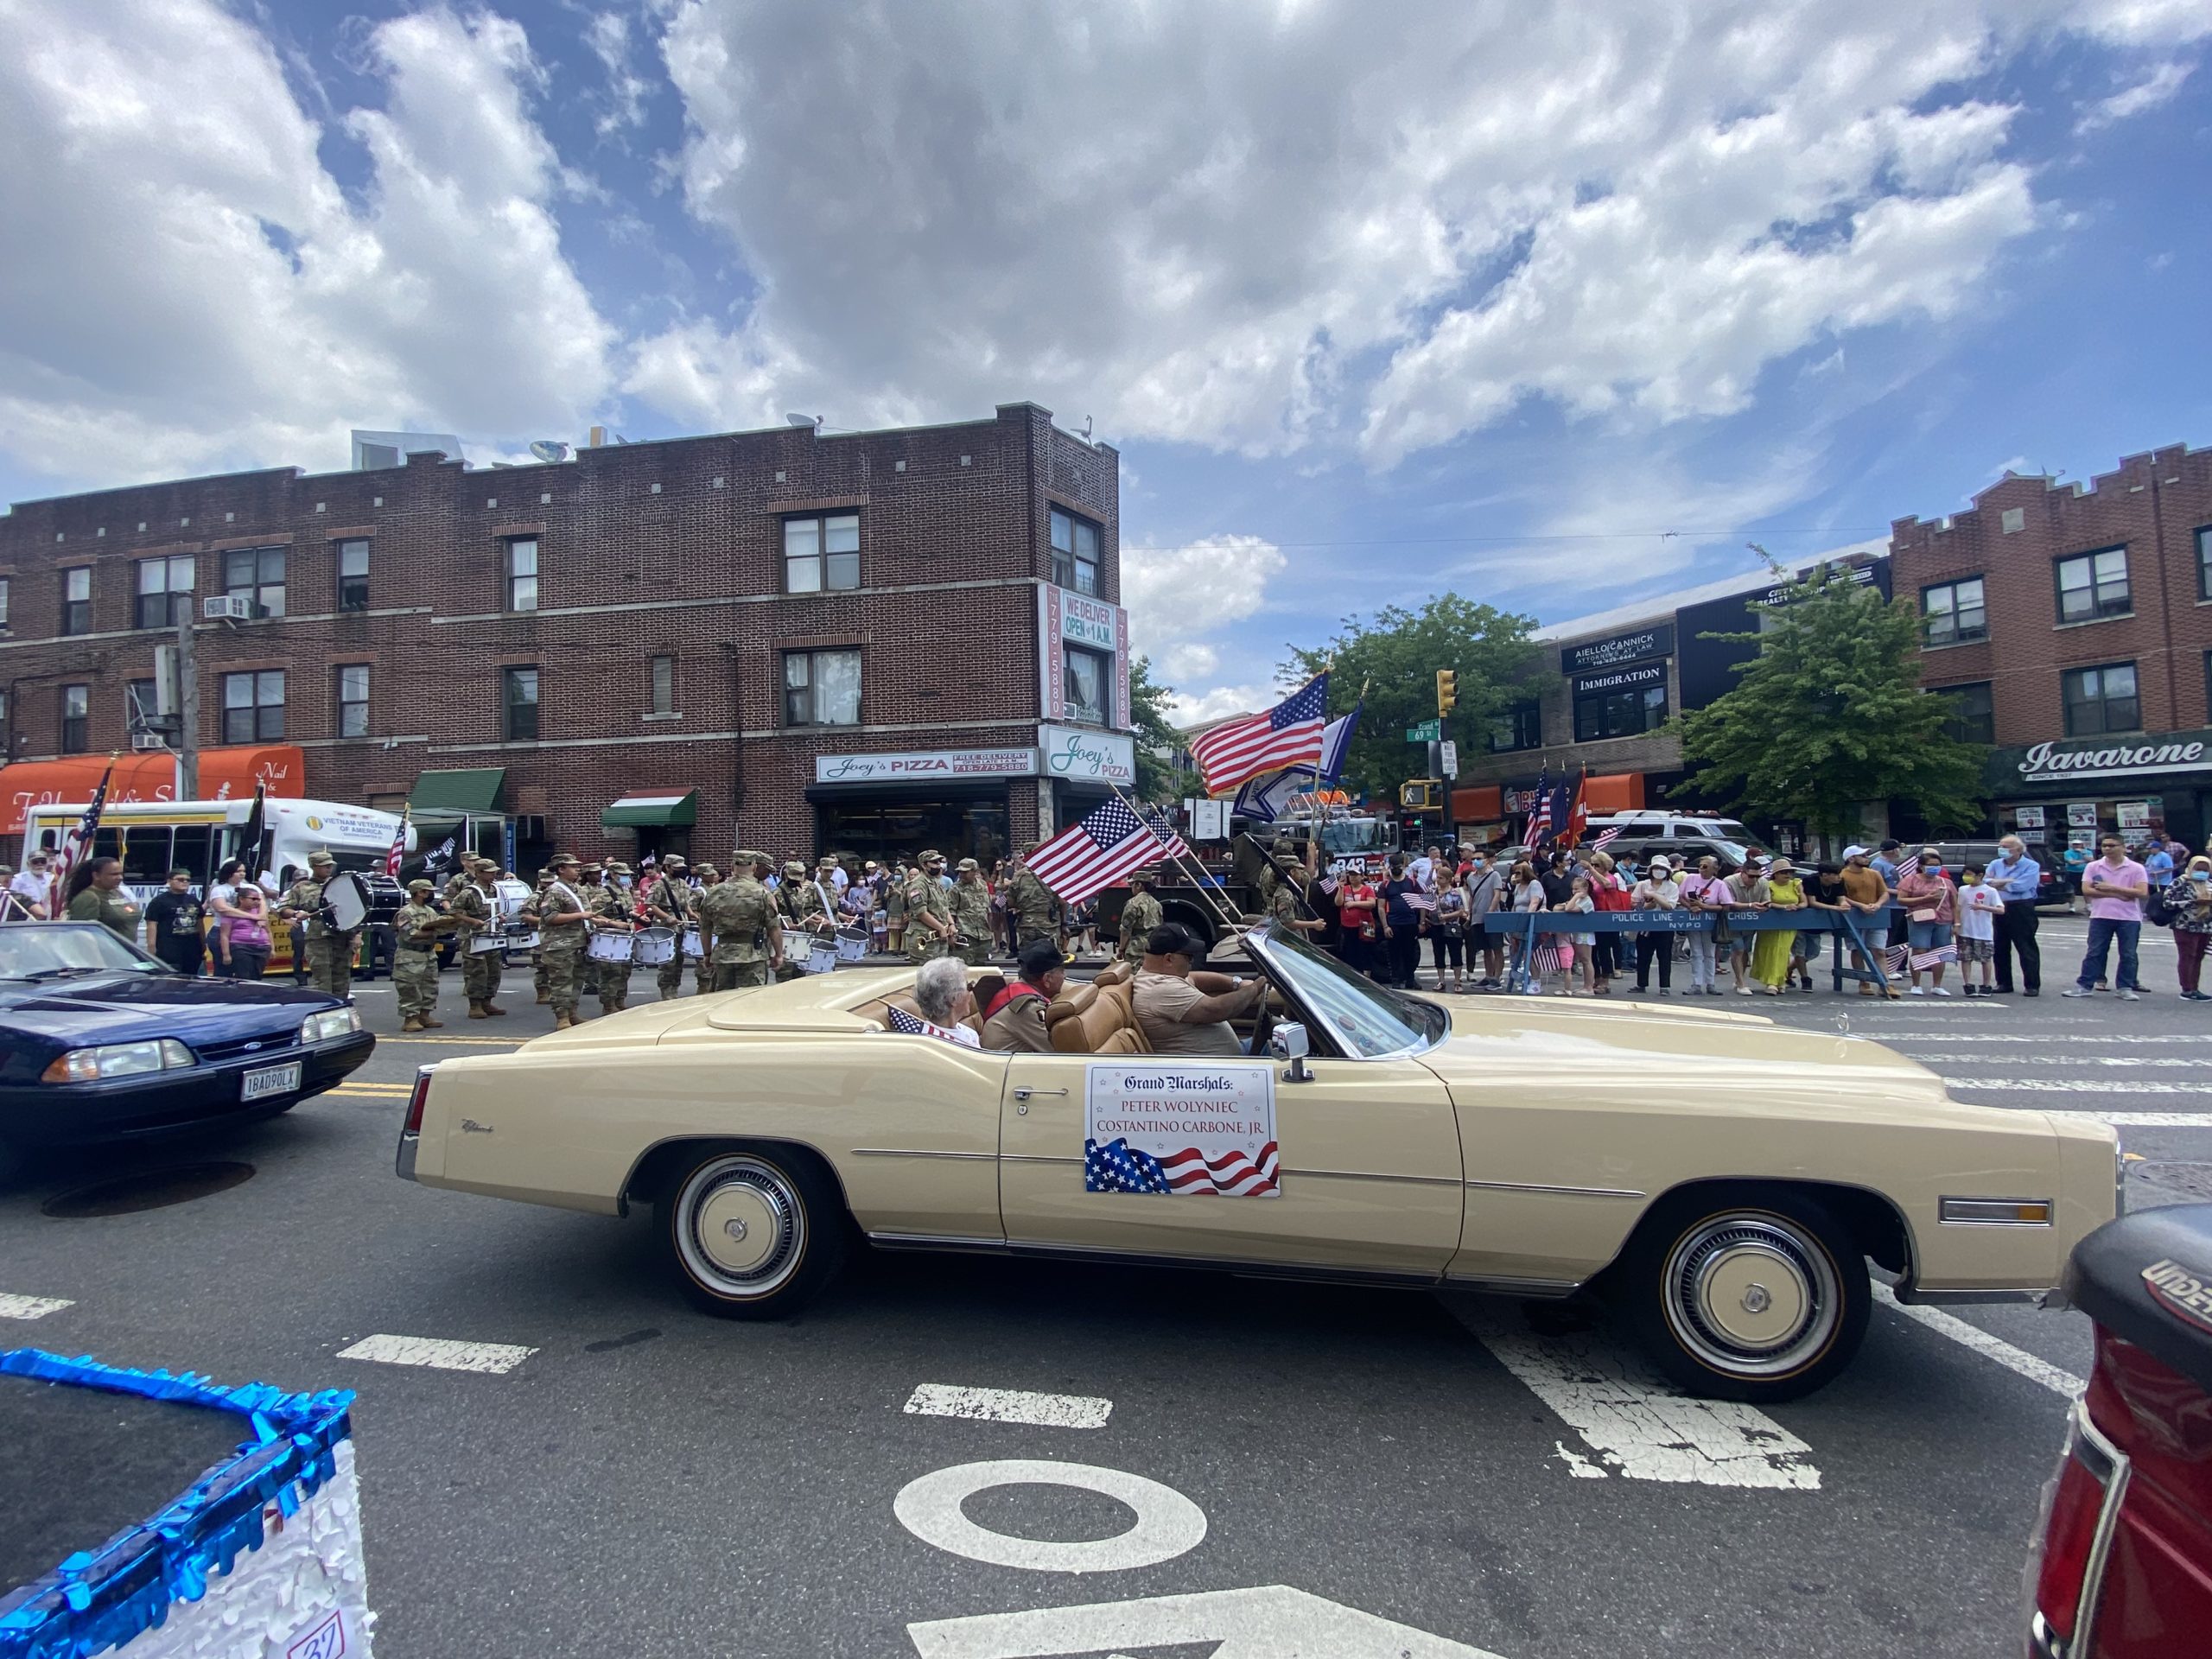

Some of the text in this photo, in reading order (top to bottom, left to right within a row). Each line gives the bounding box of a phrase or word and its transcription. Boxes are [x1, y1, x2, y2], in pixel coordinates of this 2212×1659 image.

[1066, 596, 1110, 626] WE DELIVER
[1065, 615, 1085, 637] OPEN
[1091, 623, 1095, 640] 1
[1096, 626, 1111, 645] A.M.
[1051, 604, 1059, 713] 779-5880
[1577, 650, 1618, 664] ATTORNEYS
[1414, 730, 1424, 740] 69
[1051, 735, 1114, 775] Joey's
[257, 761, 289, 779] Nail
[827, 759, 949, 778] Joey's PIZZA
[954, 763, 1027, 772] 718-779-5880
[1102, 764, 1130, 778] PIZZA
[356, 820, 392, 830] VETERANS
[1336, 857, 1365, 873] 343
[1612, 913, 1644, 922] POLICE
[1653, 912, 1673, 922] LINE
[1688, 912, 1700, 921] DO
[1728, 912, 1759, 920] CROSS
[1124, 1076, 1233, 1093] Grand Marshals:
[1122, 1100, 1238, 1113] PETER WOLYNIEC
[1096, 1120, 1264, 1136] COSTANTINO CARBONE, JR.
